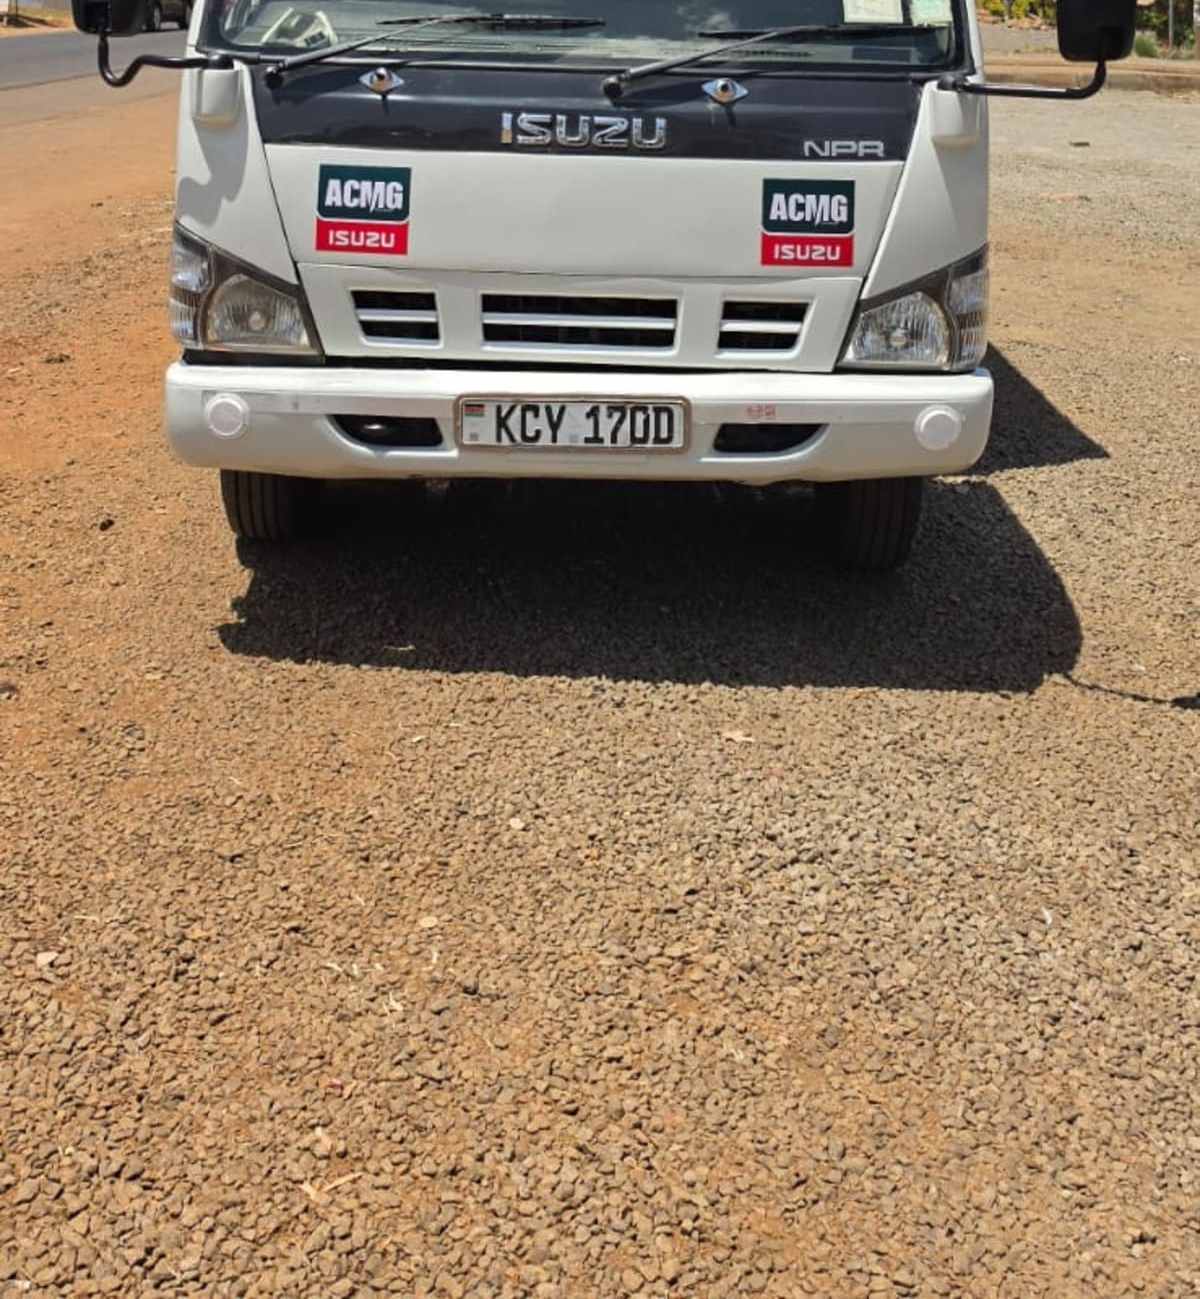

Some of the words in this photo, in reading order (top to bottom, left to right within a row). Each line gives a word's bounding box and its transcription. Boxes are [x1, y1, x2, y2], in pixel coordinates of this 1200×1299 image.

[501, 112, 667, 149] ISUZU
[804, 141, 884, 157] NPR
[325, 179, 403, 213] ACMG
[769, 193, 848, 226] ACMG
[328, 230, 395, 248] ISUZU
[773, 244, 841, 261] ISUZU
[496, 404, 566, 444] KCY
[584, 405, 674, 444] 170D
